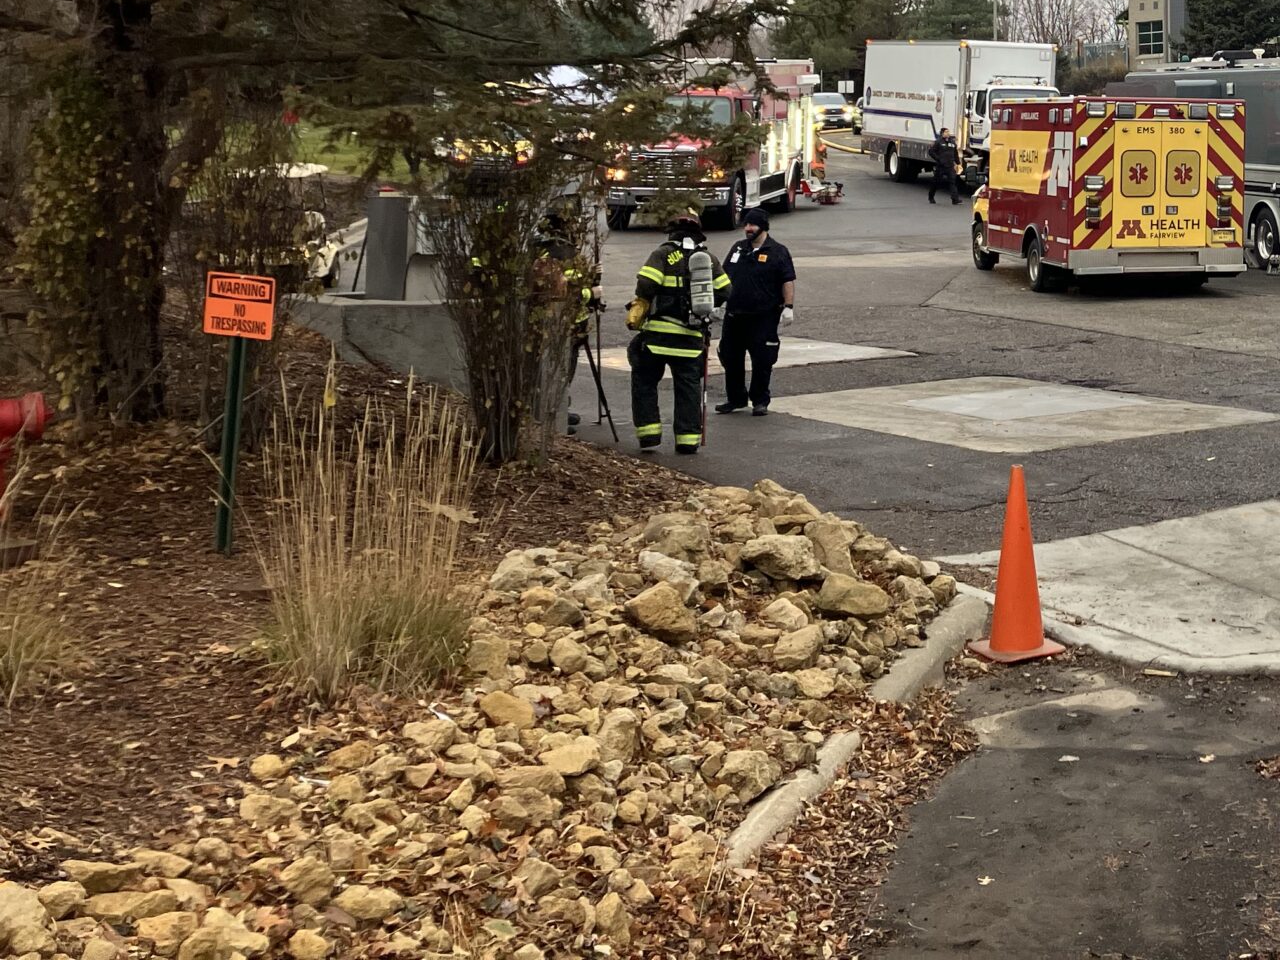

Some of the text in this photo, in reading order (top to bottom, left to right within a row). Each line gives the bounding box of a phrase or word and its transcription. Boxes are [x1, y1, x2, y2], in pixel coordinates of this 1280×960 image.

[1020, 112, 1040, 120] AMBULANCE
[1019, 150, 1038, 164] HEALTH
[1150, 219, 1200, 230] HEALTH
[216, 280, 266, 298] WARNING
[234, 304, 246, 318] NO
[210, 316, 266, 335] TRESPASSING
